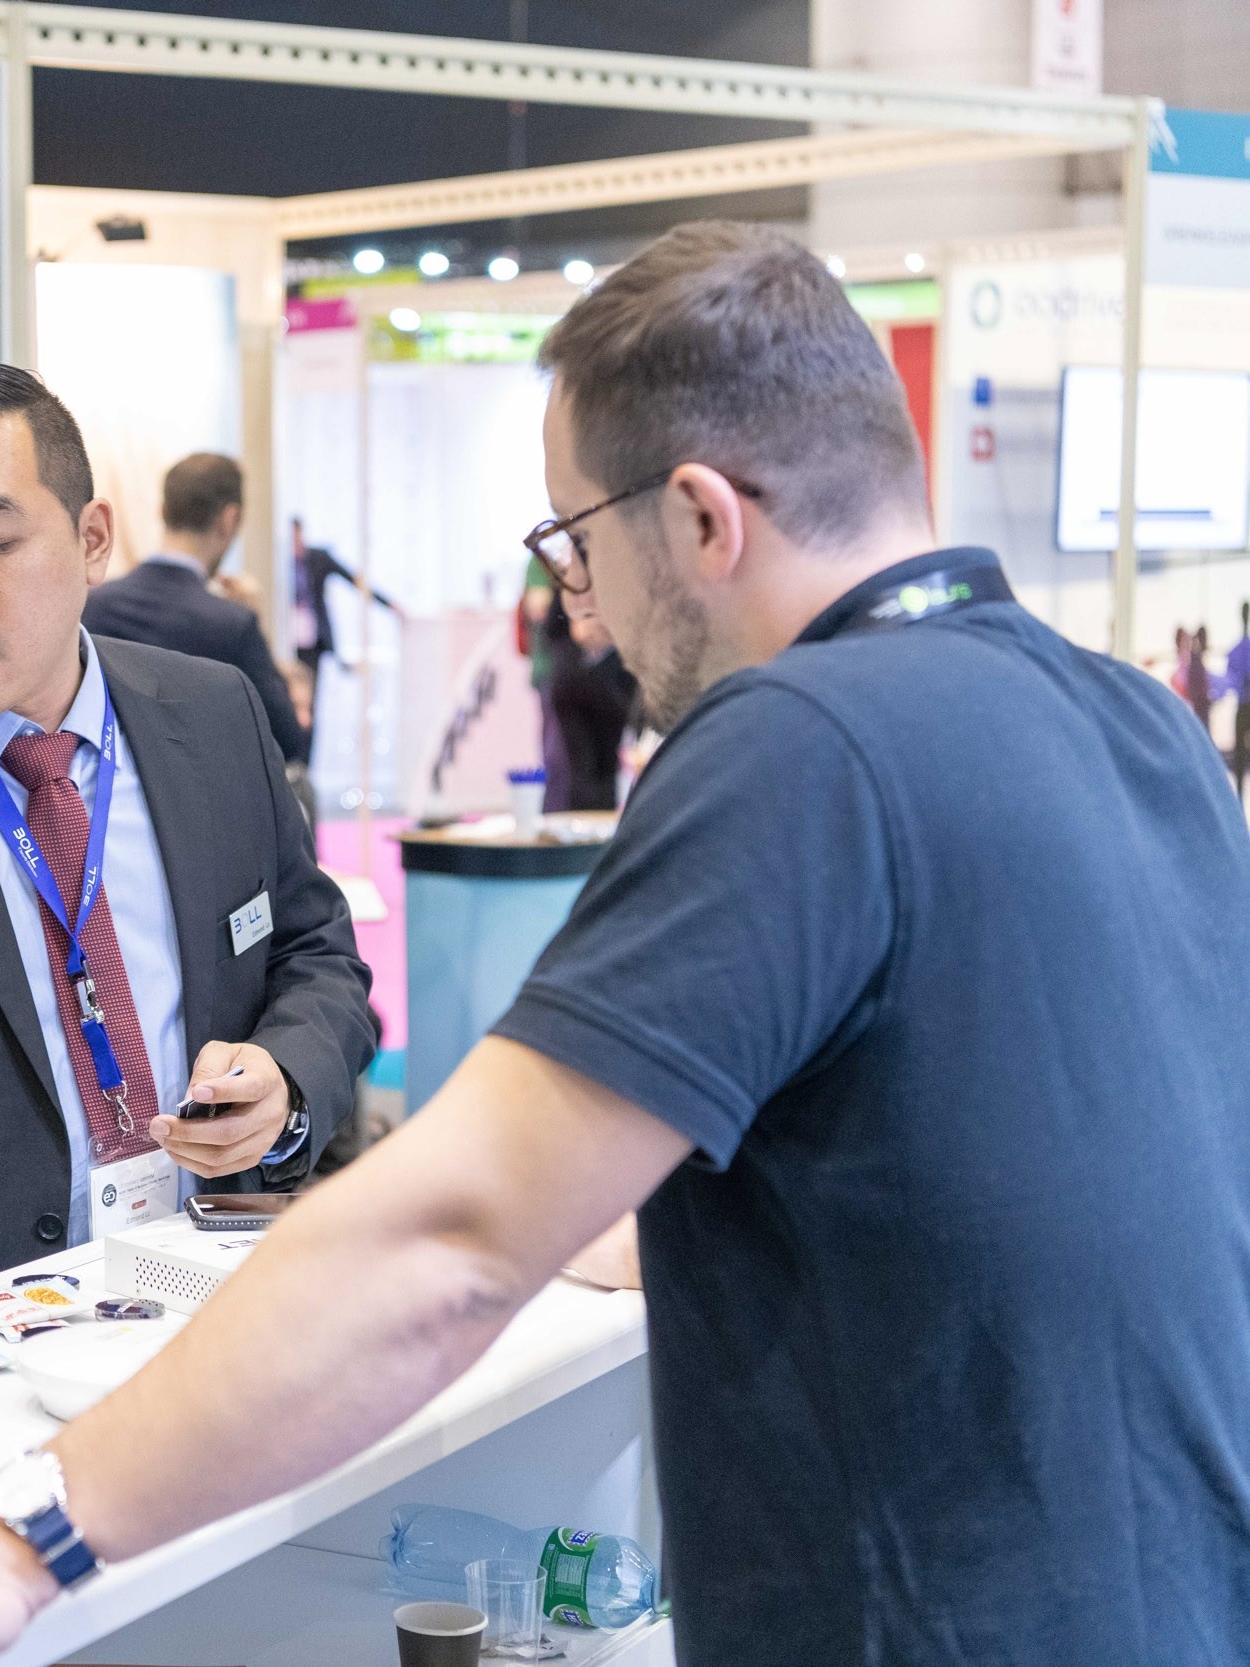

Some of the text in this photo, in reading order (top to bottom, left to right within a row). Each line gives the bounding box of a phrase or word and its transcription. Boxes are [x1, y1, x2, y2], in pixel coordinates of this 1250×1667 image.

[104, 724, 113, 761] BOLL
[12, 827, 39, 868] BOLL
[83, 866, 97, 907] BOLL
